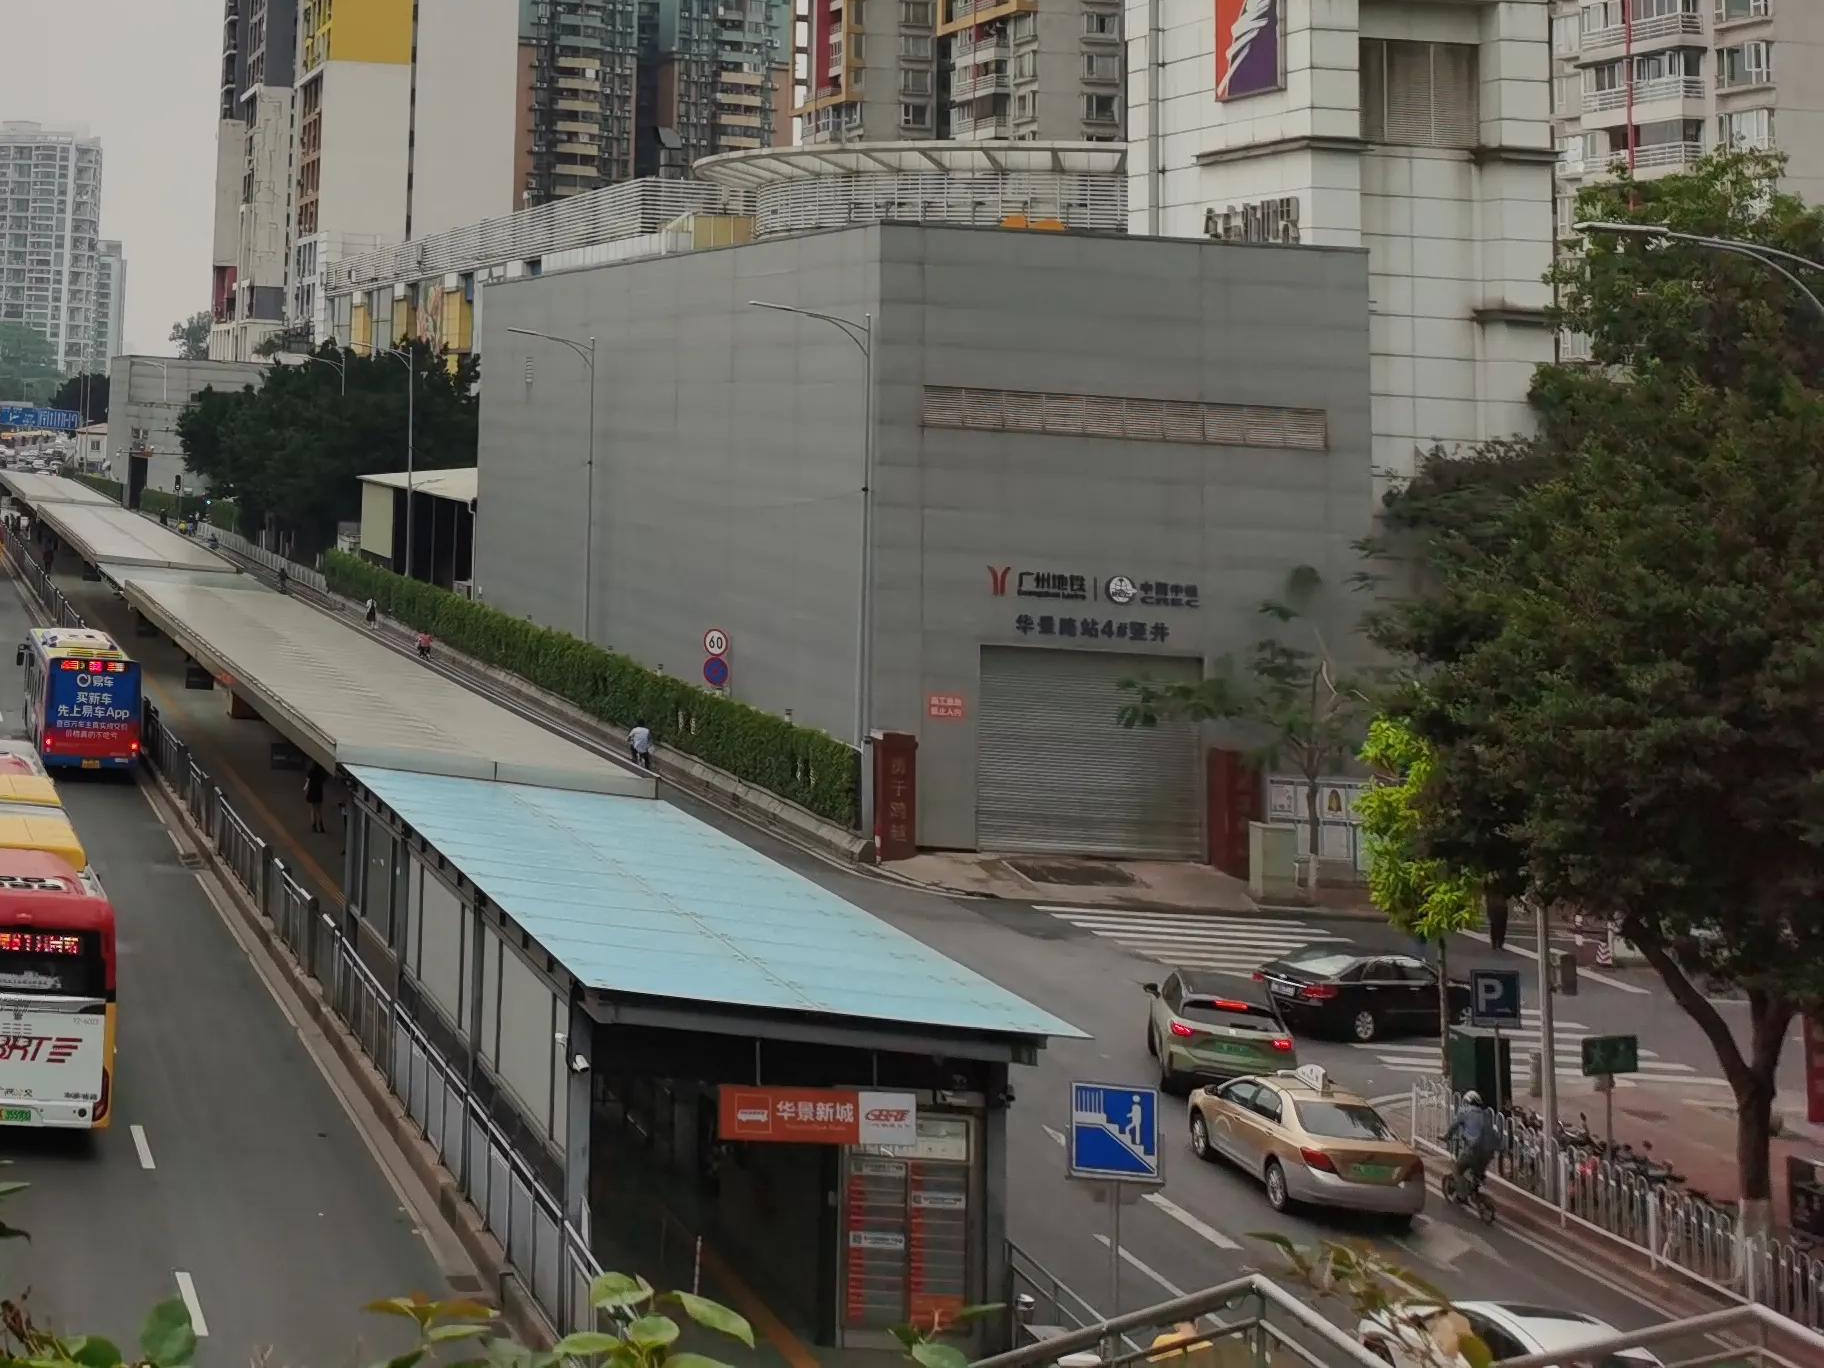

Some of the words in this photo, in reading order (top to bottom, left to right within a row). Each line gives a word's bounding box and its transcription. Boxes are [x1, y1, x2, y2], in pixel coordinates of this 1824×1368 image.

[1017, 571, 1086, 592] 广州地铁
[708, 636, 723, 650] 60
[92, 675, 115, 688] 易车
[76, 691, 113, 705] 买新车
[57, 704, 130, 720] 先上易车App
[1477, 977, 1504, 1013] P
[776, 1100, 855, 1123] 华景新城
